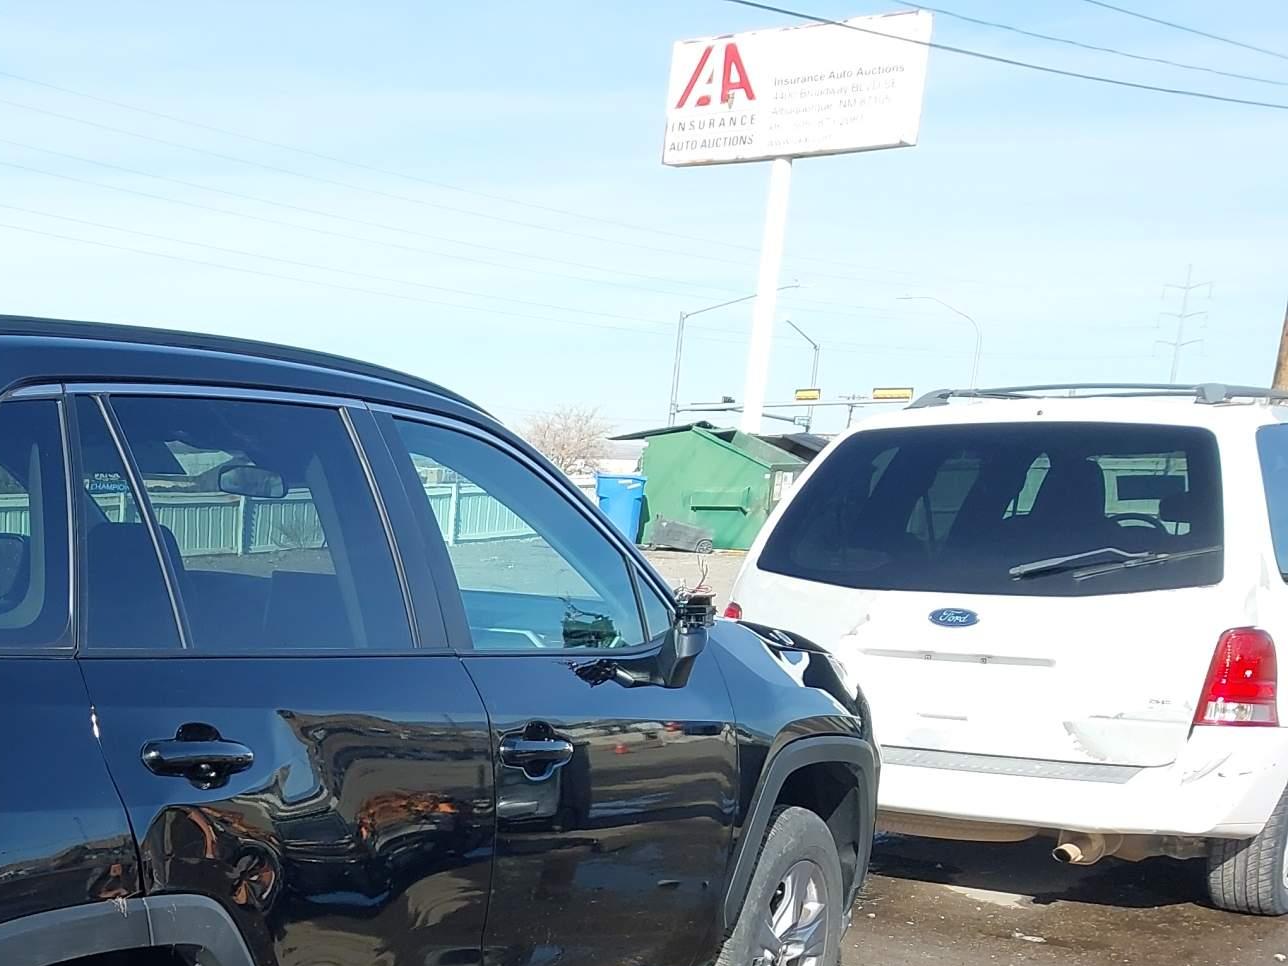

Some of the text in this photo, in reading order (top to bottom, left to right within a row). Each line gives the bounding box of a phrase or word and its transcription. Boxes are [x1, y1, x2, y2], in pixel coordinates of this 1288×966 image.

[773, 63, 905, 87] Insurance Auto Auctions
[671, 114, 756, 132] INSURANCE
[669, 139, 698, 152] AUTO
[700, 135, 754, 149] AUCTIONS
[939, 610, 970, 622] Ford
